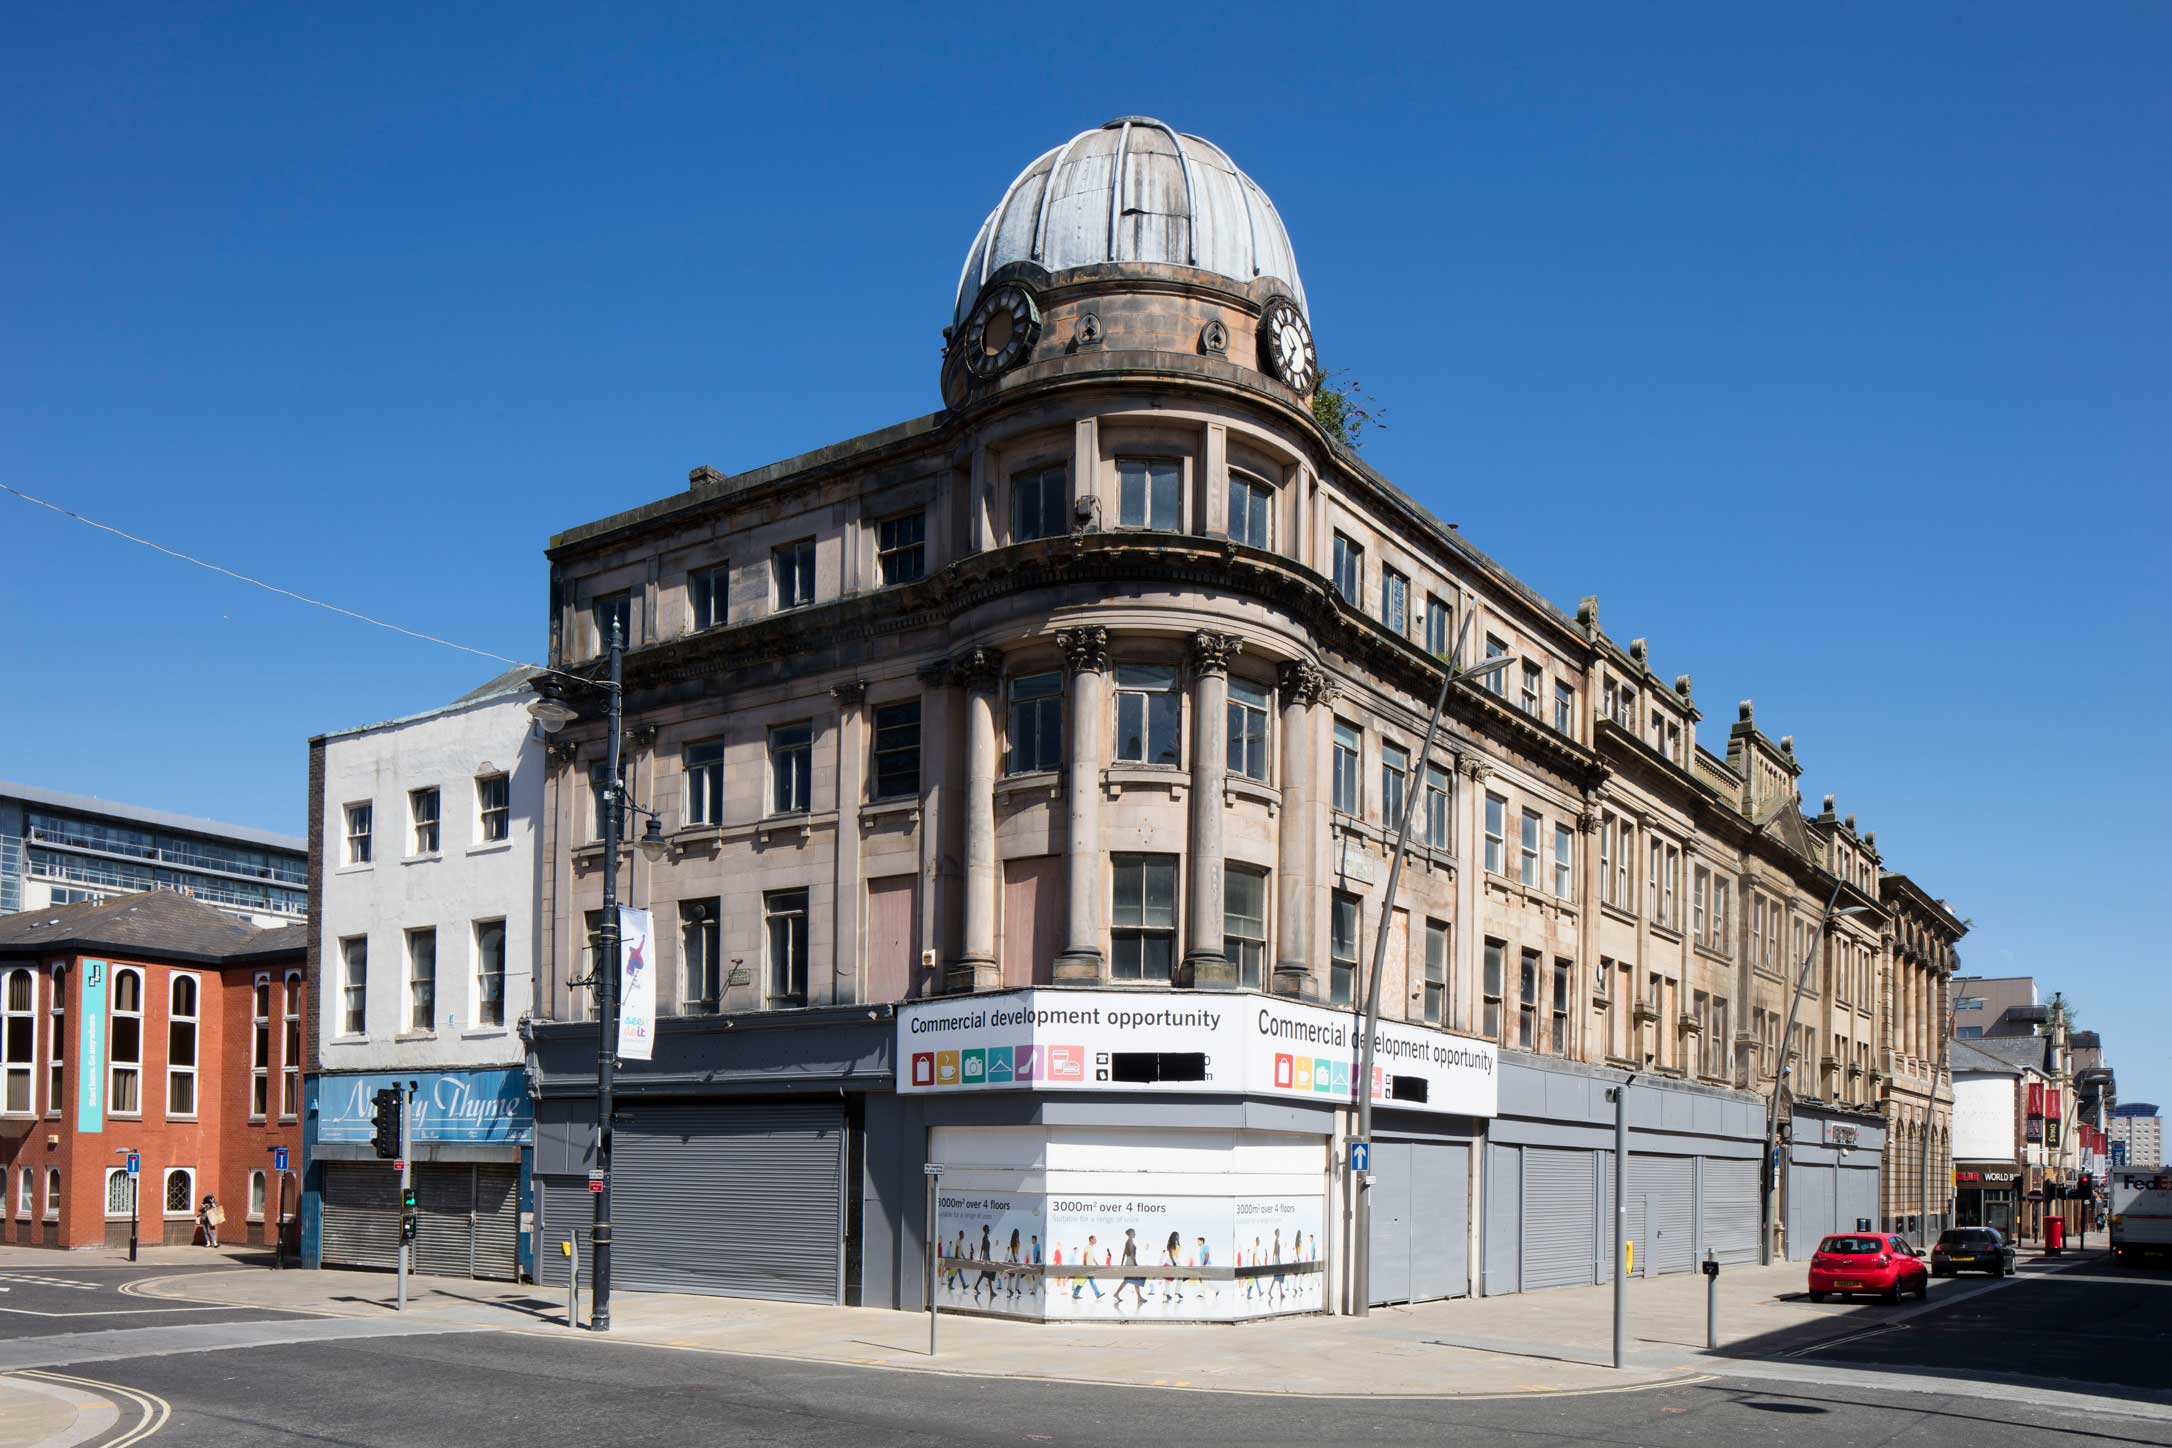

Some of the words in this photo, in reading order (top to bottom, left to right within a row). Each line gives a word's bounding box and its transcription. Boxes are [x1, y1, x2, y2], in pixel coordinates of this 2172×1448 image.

[911, 1011, 986, 1034] Commercial
[991, 1007, 1100, 1029] development
[1107, 1008, 1221, 1031] opportunity
[1258, 1009, 1346, 1047] Commercial
[1351, 1028, 1430, 1061] deelopment
[1433, 1045, 1493, 1075] opportunity
[434, 1076, 521, 1127] Thyme
[1984, 1172, 2009, 1182] WORLD
[966, 1201, 981, 1209] over
[982, 1200, 988, 1209] 4
[991, 1200, 1010, 1210] floors
[1100, 1204, 1122, 1212] over
[1125, 1202, 1133, 1212] 4
[1137, 1202, 1166, 1213] floors
[1261, 1206, 1273, 1214] over
[1274, 1203, 1279, 1212] 4
[1280, 1203, 1296, 1213] floors
